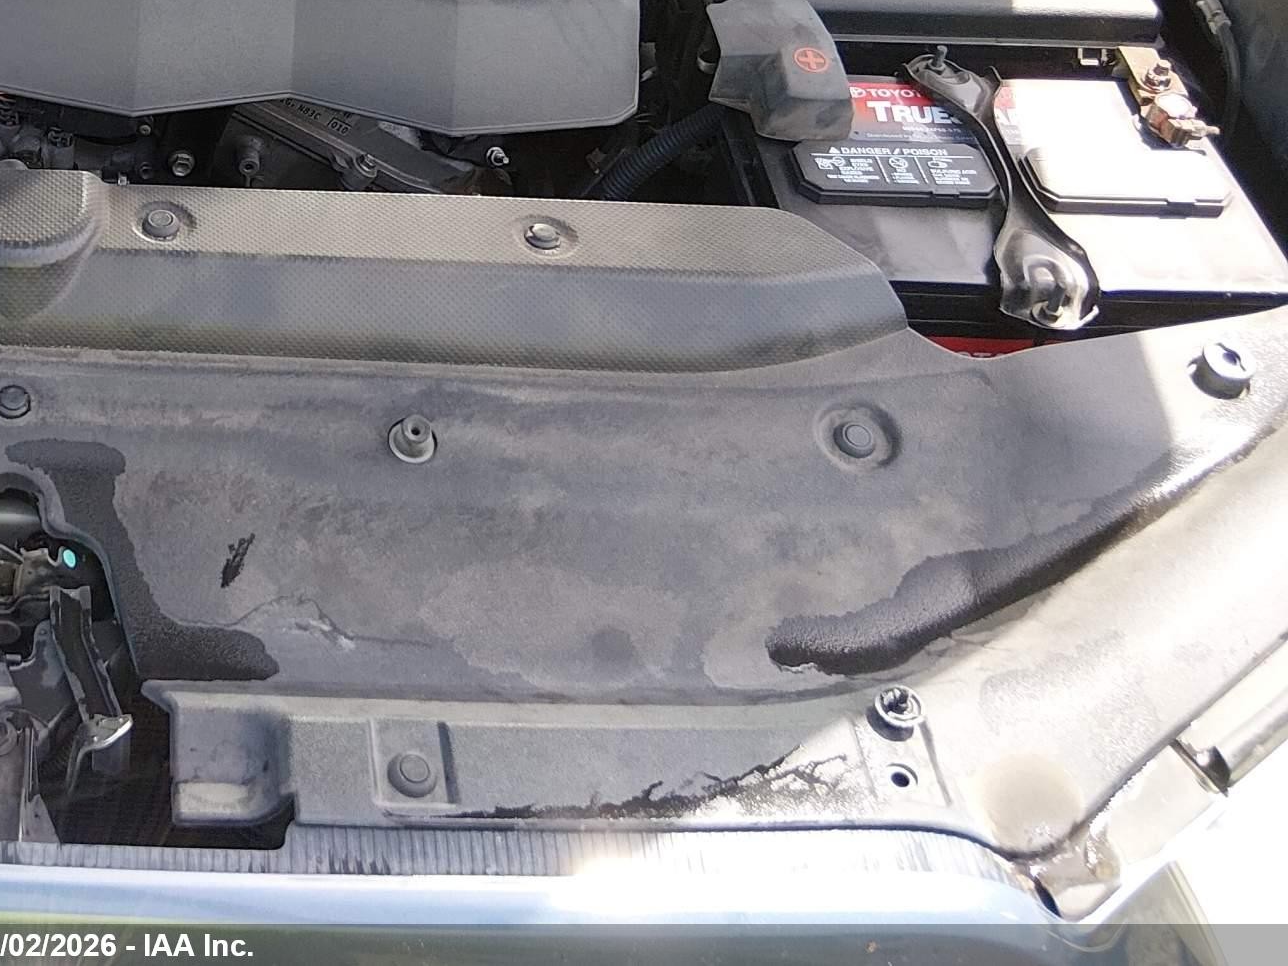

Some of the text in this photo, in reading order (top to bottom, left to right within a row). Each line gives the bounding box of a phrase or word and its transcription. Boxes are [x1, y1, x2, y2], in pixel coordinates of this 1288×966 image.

[867, 88, 922, 98] TOYOT
[866, 100, 963, 125] TRUE
[840, 147, 892, 155] DANGER
[902, 148, 948, 156] POISON
